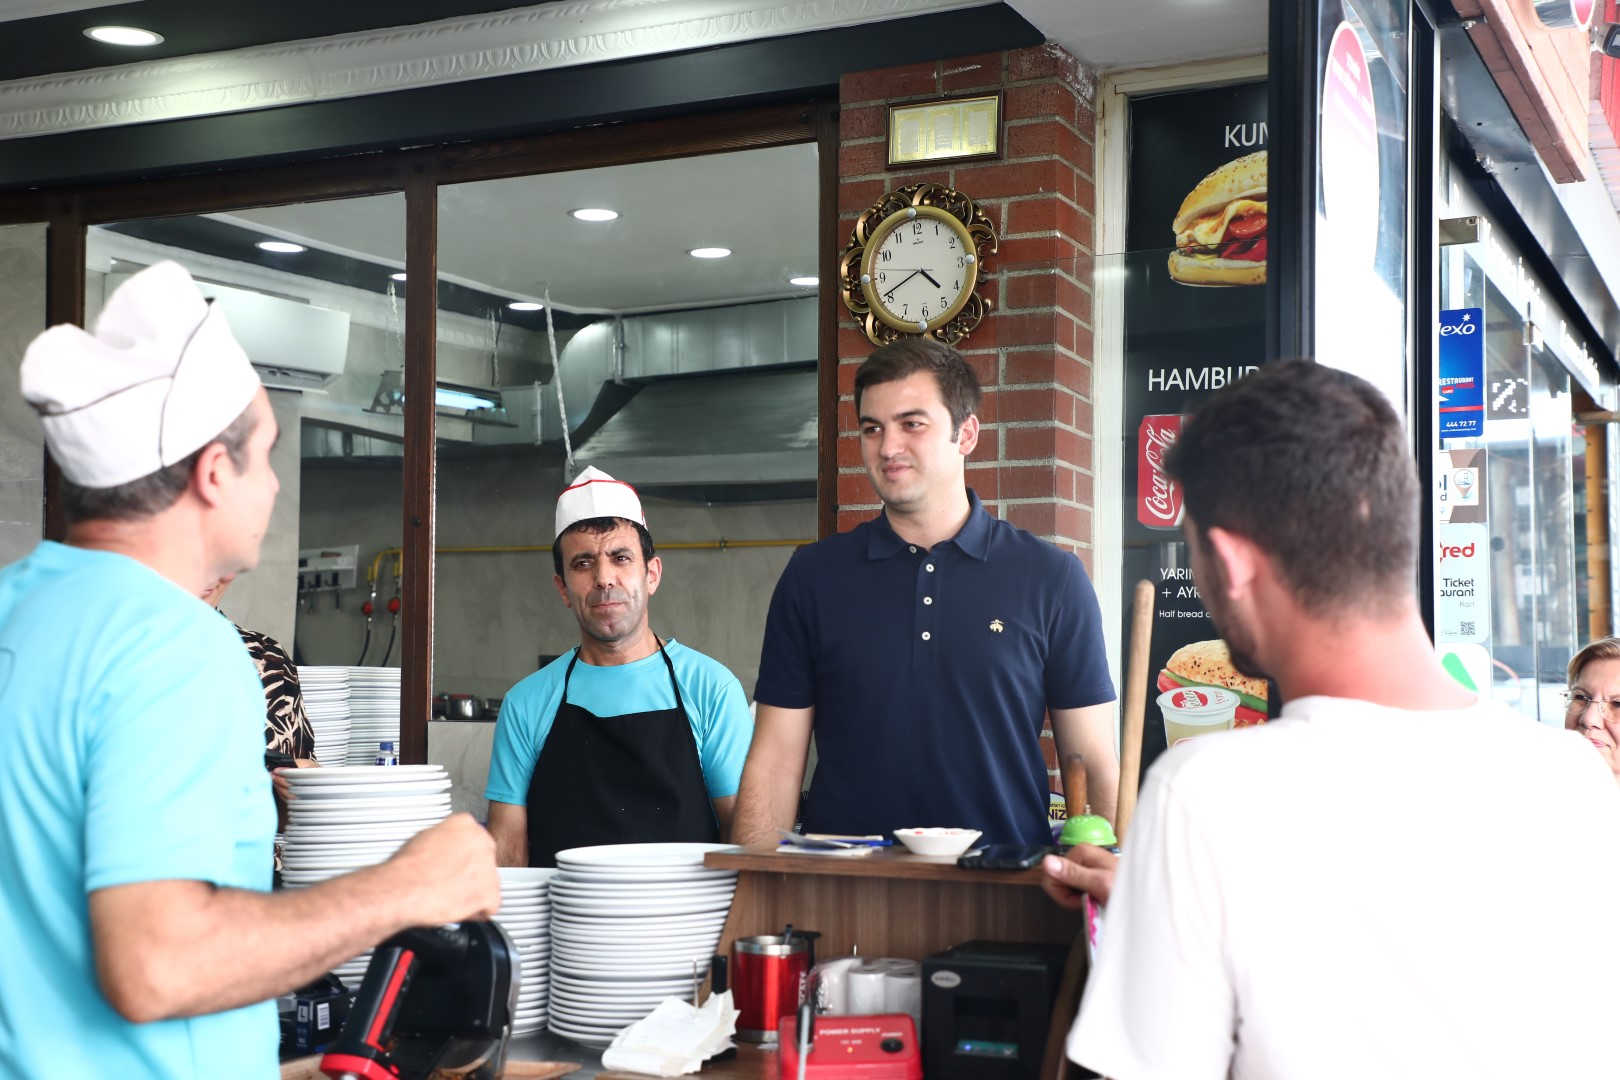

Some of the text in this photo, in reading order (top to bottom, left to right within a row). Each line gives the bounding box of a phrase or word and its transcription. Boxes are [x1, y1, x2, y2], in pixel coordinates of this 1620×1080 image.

[913, 222, 922, 235] 12
[895, 232, 903, 244] 11
[949, 237, 955, 249] 2
[881, 250, 892, 262] 10
[957, 256, 964, 269] 3
[879, 272, 886, 283] 9
[953, 280, 959, 292] 4
[940, 297, 948, 309] 5
[902, 304, 909, 316] 7
[921, 304, 929, 317] 6
[1439, 320, 1476, 337] exo
[1145, 423, 1177, 520] Coca-Cla
[1443, 577, 1475, 588] Ticket
[1159, 610, 1176, 618] Half
[1177, 610, 1204, 618] bread
